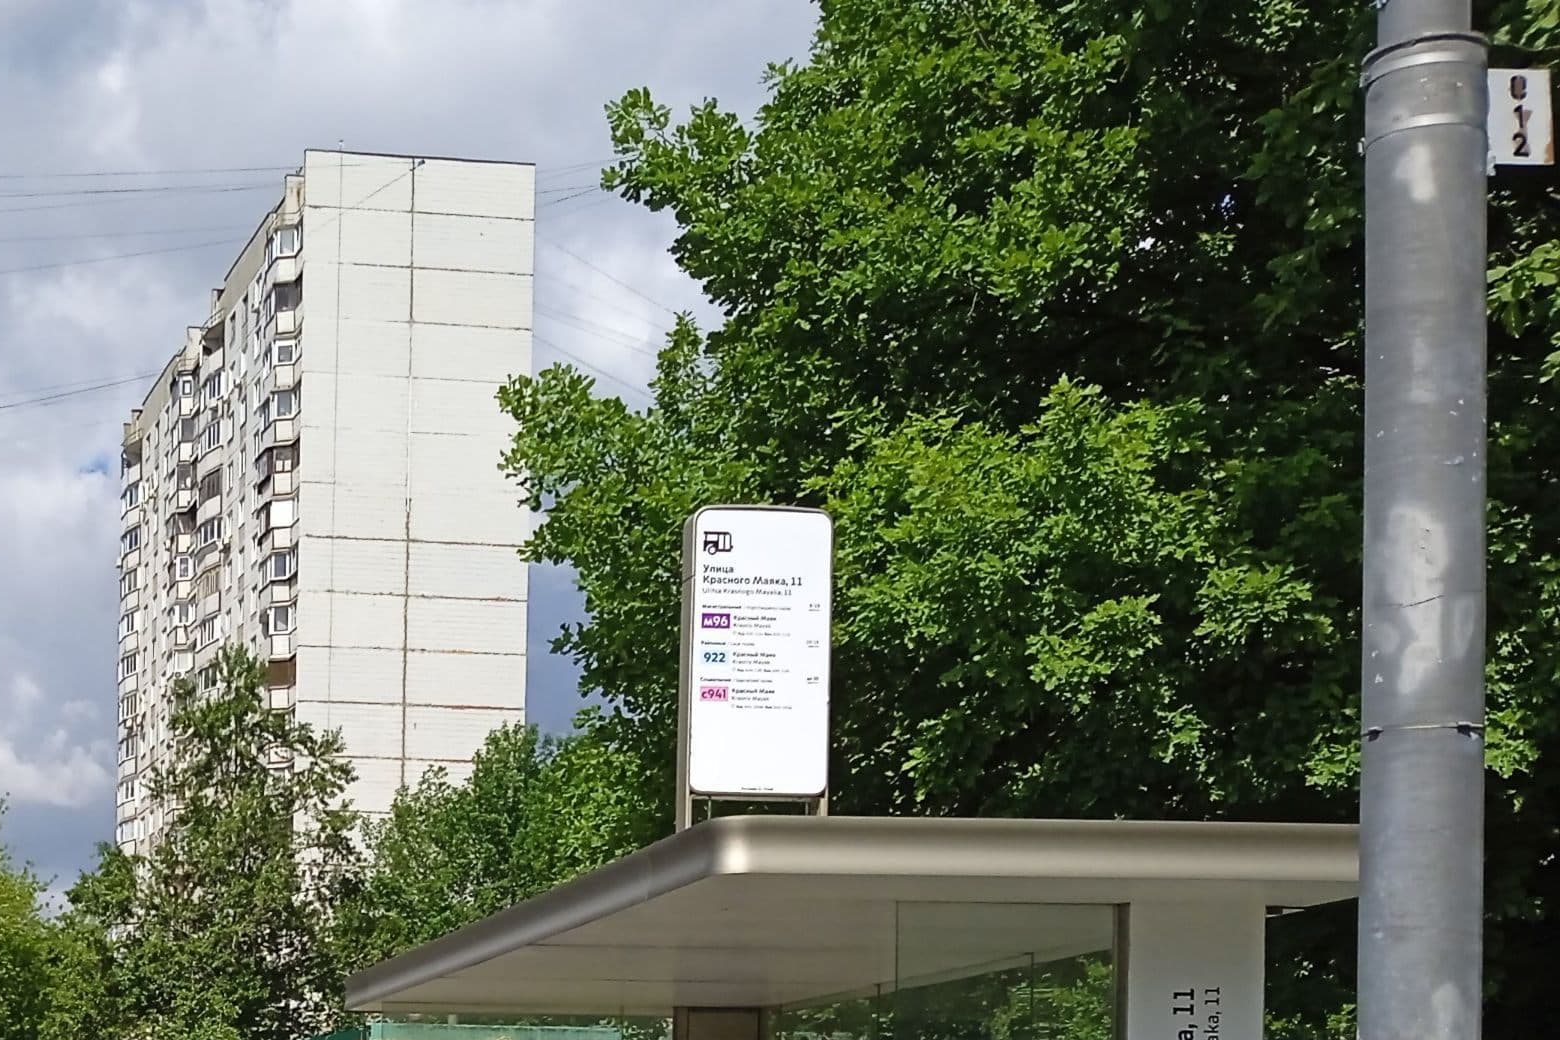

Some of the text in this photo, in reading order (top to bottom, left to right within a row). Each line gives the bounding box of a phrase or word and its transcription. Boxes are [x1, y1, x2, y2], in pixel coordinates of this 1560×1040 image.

[703, 564, 734, 574] Улица
[703, 576, 802, 586] Красного Маяка, 11
[704, 652, 726, 663] 922
[1205, 987, 1220, 1004] 11
[1173, 988, 1195, 1016] 11
